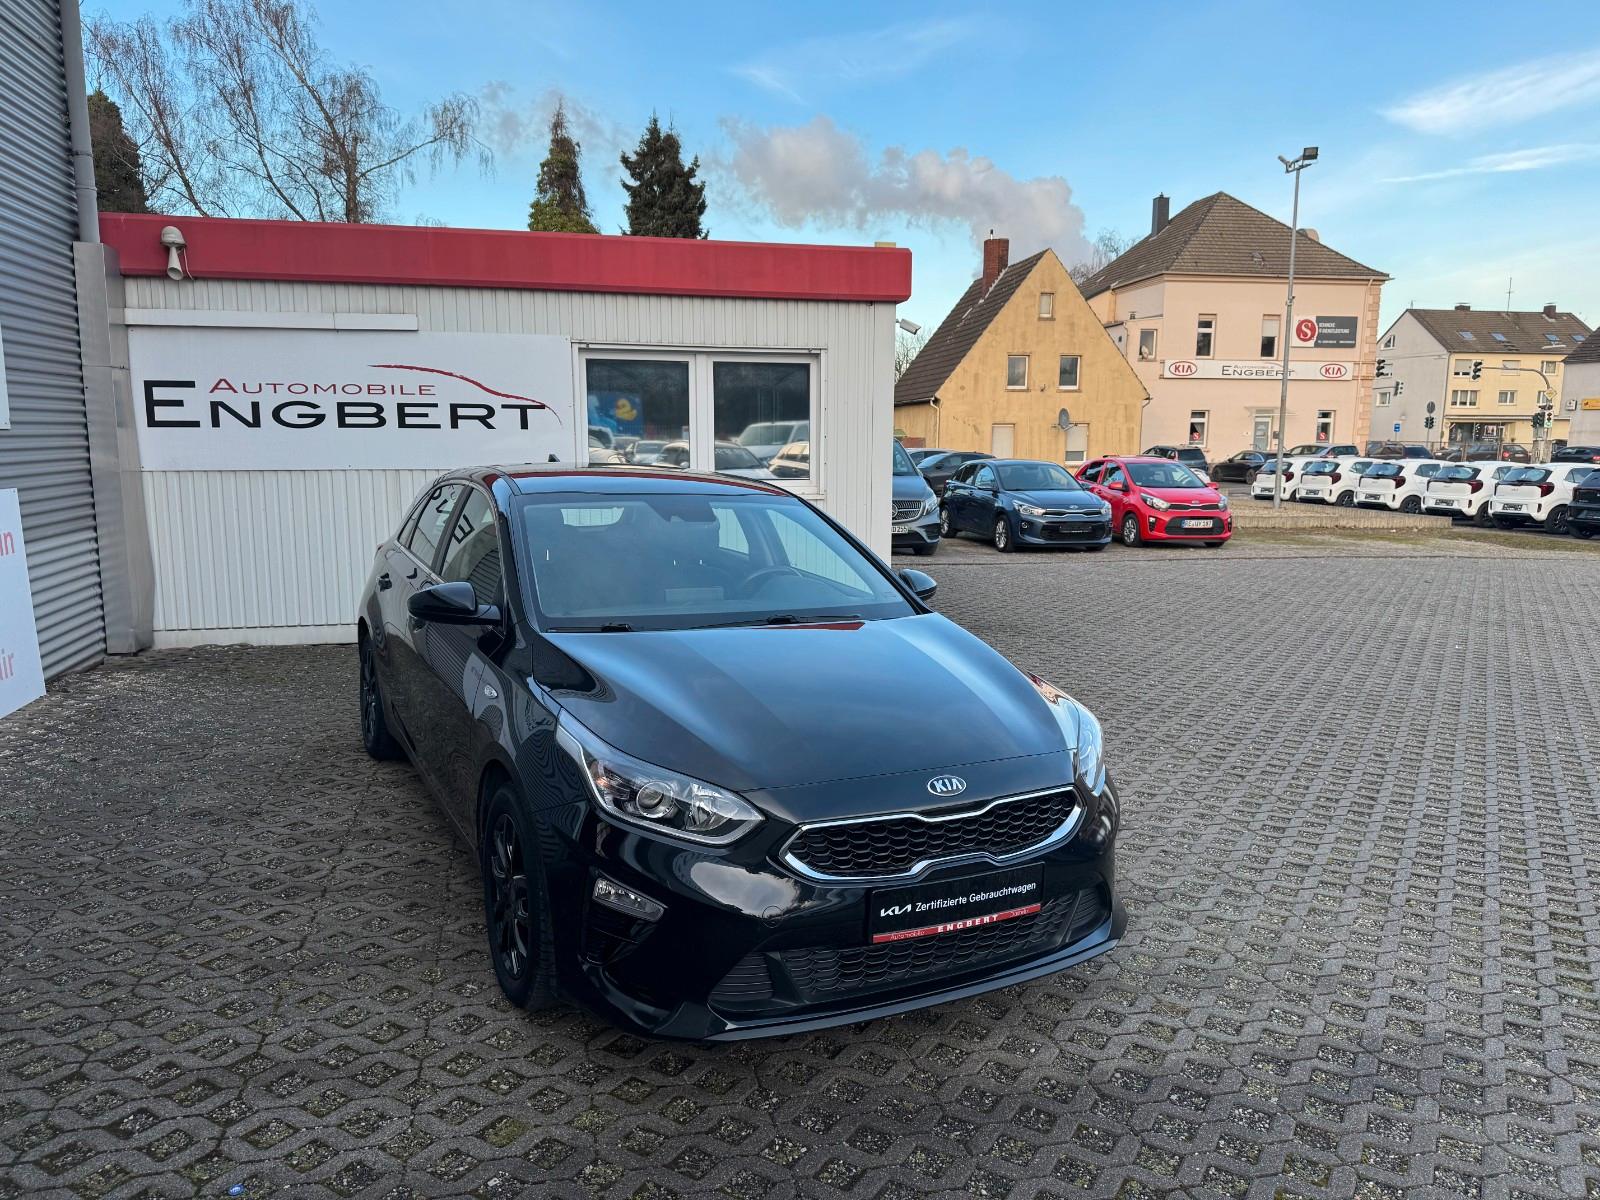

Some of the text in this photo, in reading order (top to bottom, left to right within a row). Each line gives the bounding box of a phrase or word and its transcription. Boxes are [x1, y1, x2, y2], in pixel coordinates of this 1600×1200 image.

[1174, 364, 1193, 374] KIA
[1221, 364, 1295, 377] ENGBERT
[1324, 366, 1342, 376] KIA
[208, 378, 437, 396] AUTOMOBILE
[143, 379, 546, 430] ENGBERT
[933, 778, 963, 793] KIA
[915, 896, 968, 912] Zertifizierte
[969, 882, 1037, 902] Gebrauchtwagen
[937, 914, 999, 933] ENGBERT
